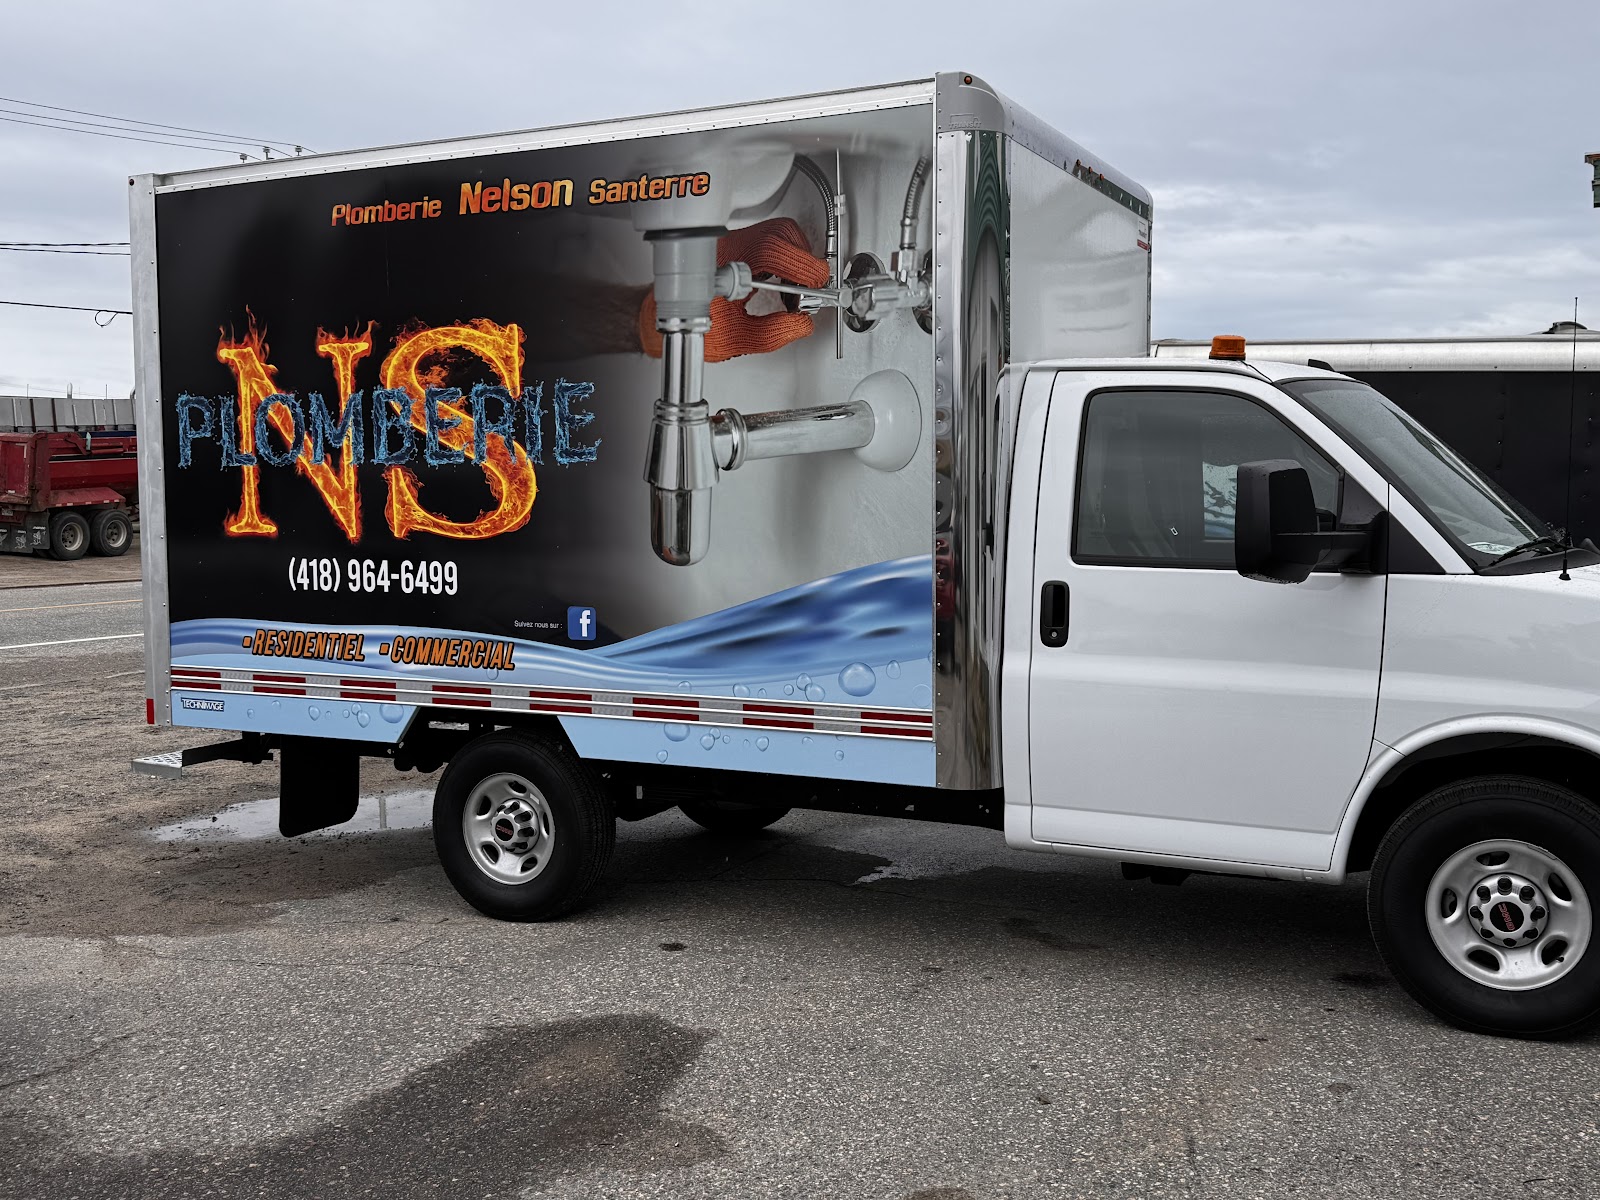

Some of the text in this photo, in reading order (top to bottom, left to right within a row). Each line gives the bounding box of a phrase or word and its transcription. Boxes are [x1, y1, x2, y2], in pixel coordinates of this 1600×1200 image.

[331, 172, 711, 226] Plomberie Nelson Santerre
[175, 377, 602, 470] PLOMBERIE
[288, 557, 458, 595] (418) 964-6499
[514, 620, 533, 628] Suivez
